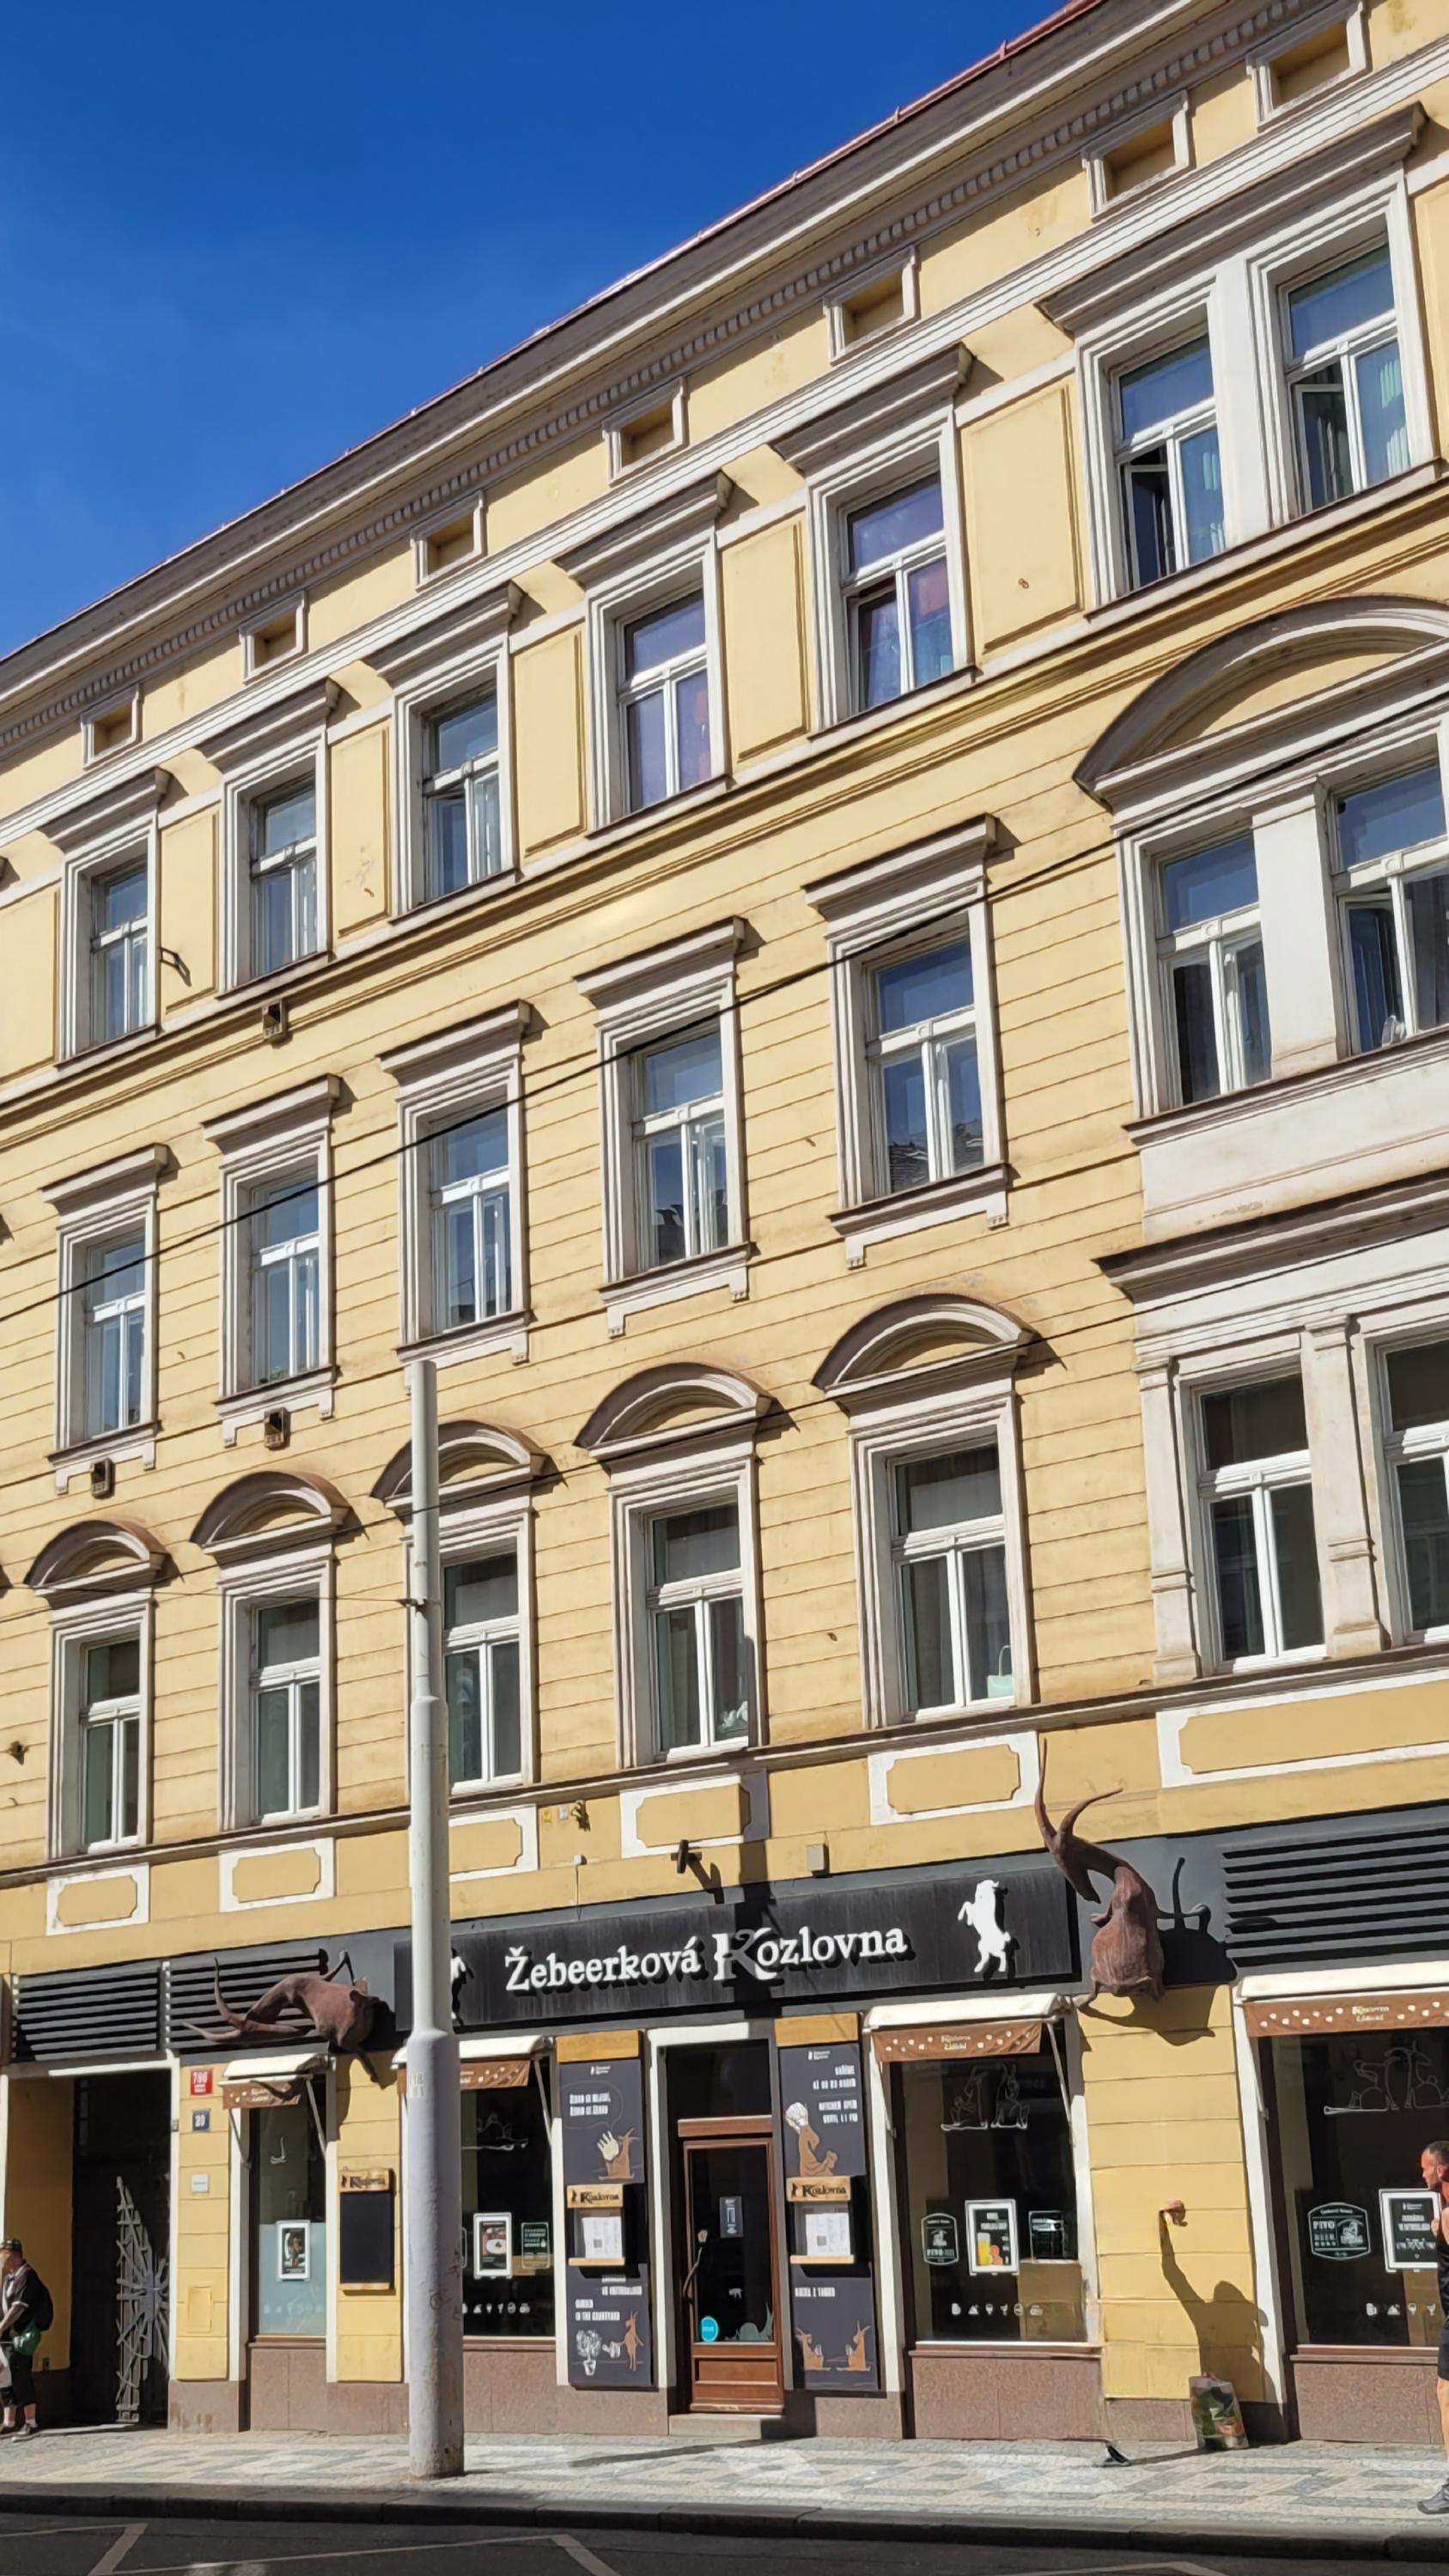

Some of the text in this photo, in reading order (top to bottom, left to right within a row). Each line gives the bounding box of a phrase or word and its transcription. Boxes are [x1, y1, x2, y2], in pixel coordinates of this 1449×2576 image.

[505, 1927, 908, 1991] Žebeerková Kozlovna
[802, 2184, 847, 2197] Kozlovna
[1312, 2221, 1336, 2230] PIVO
